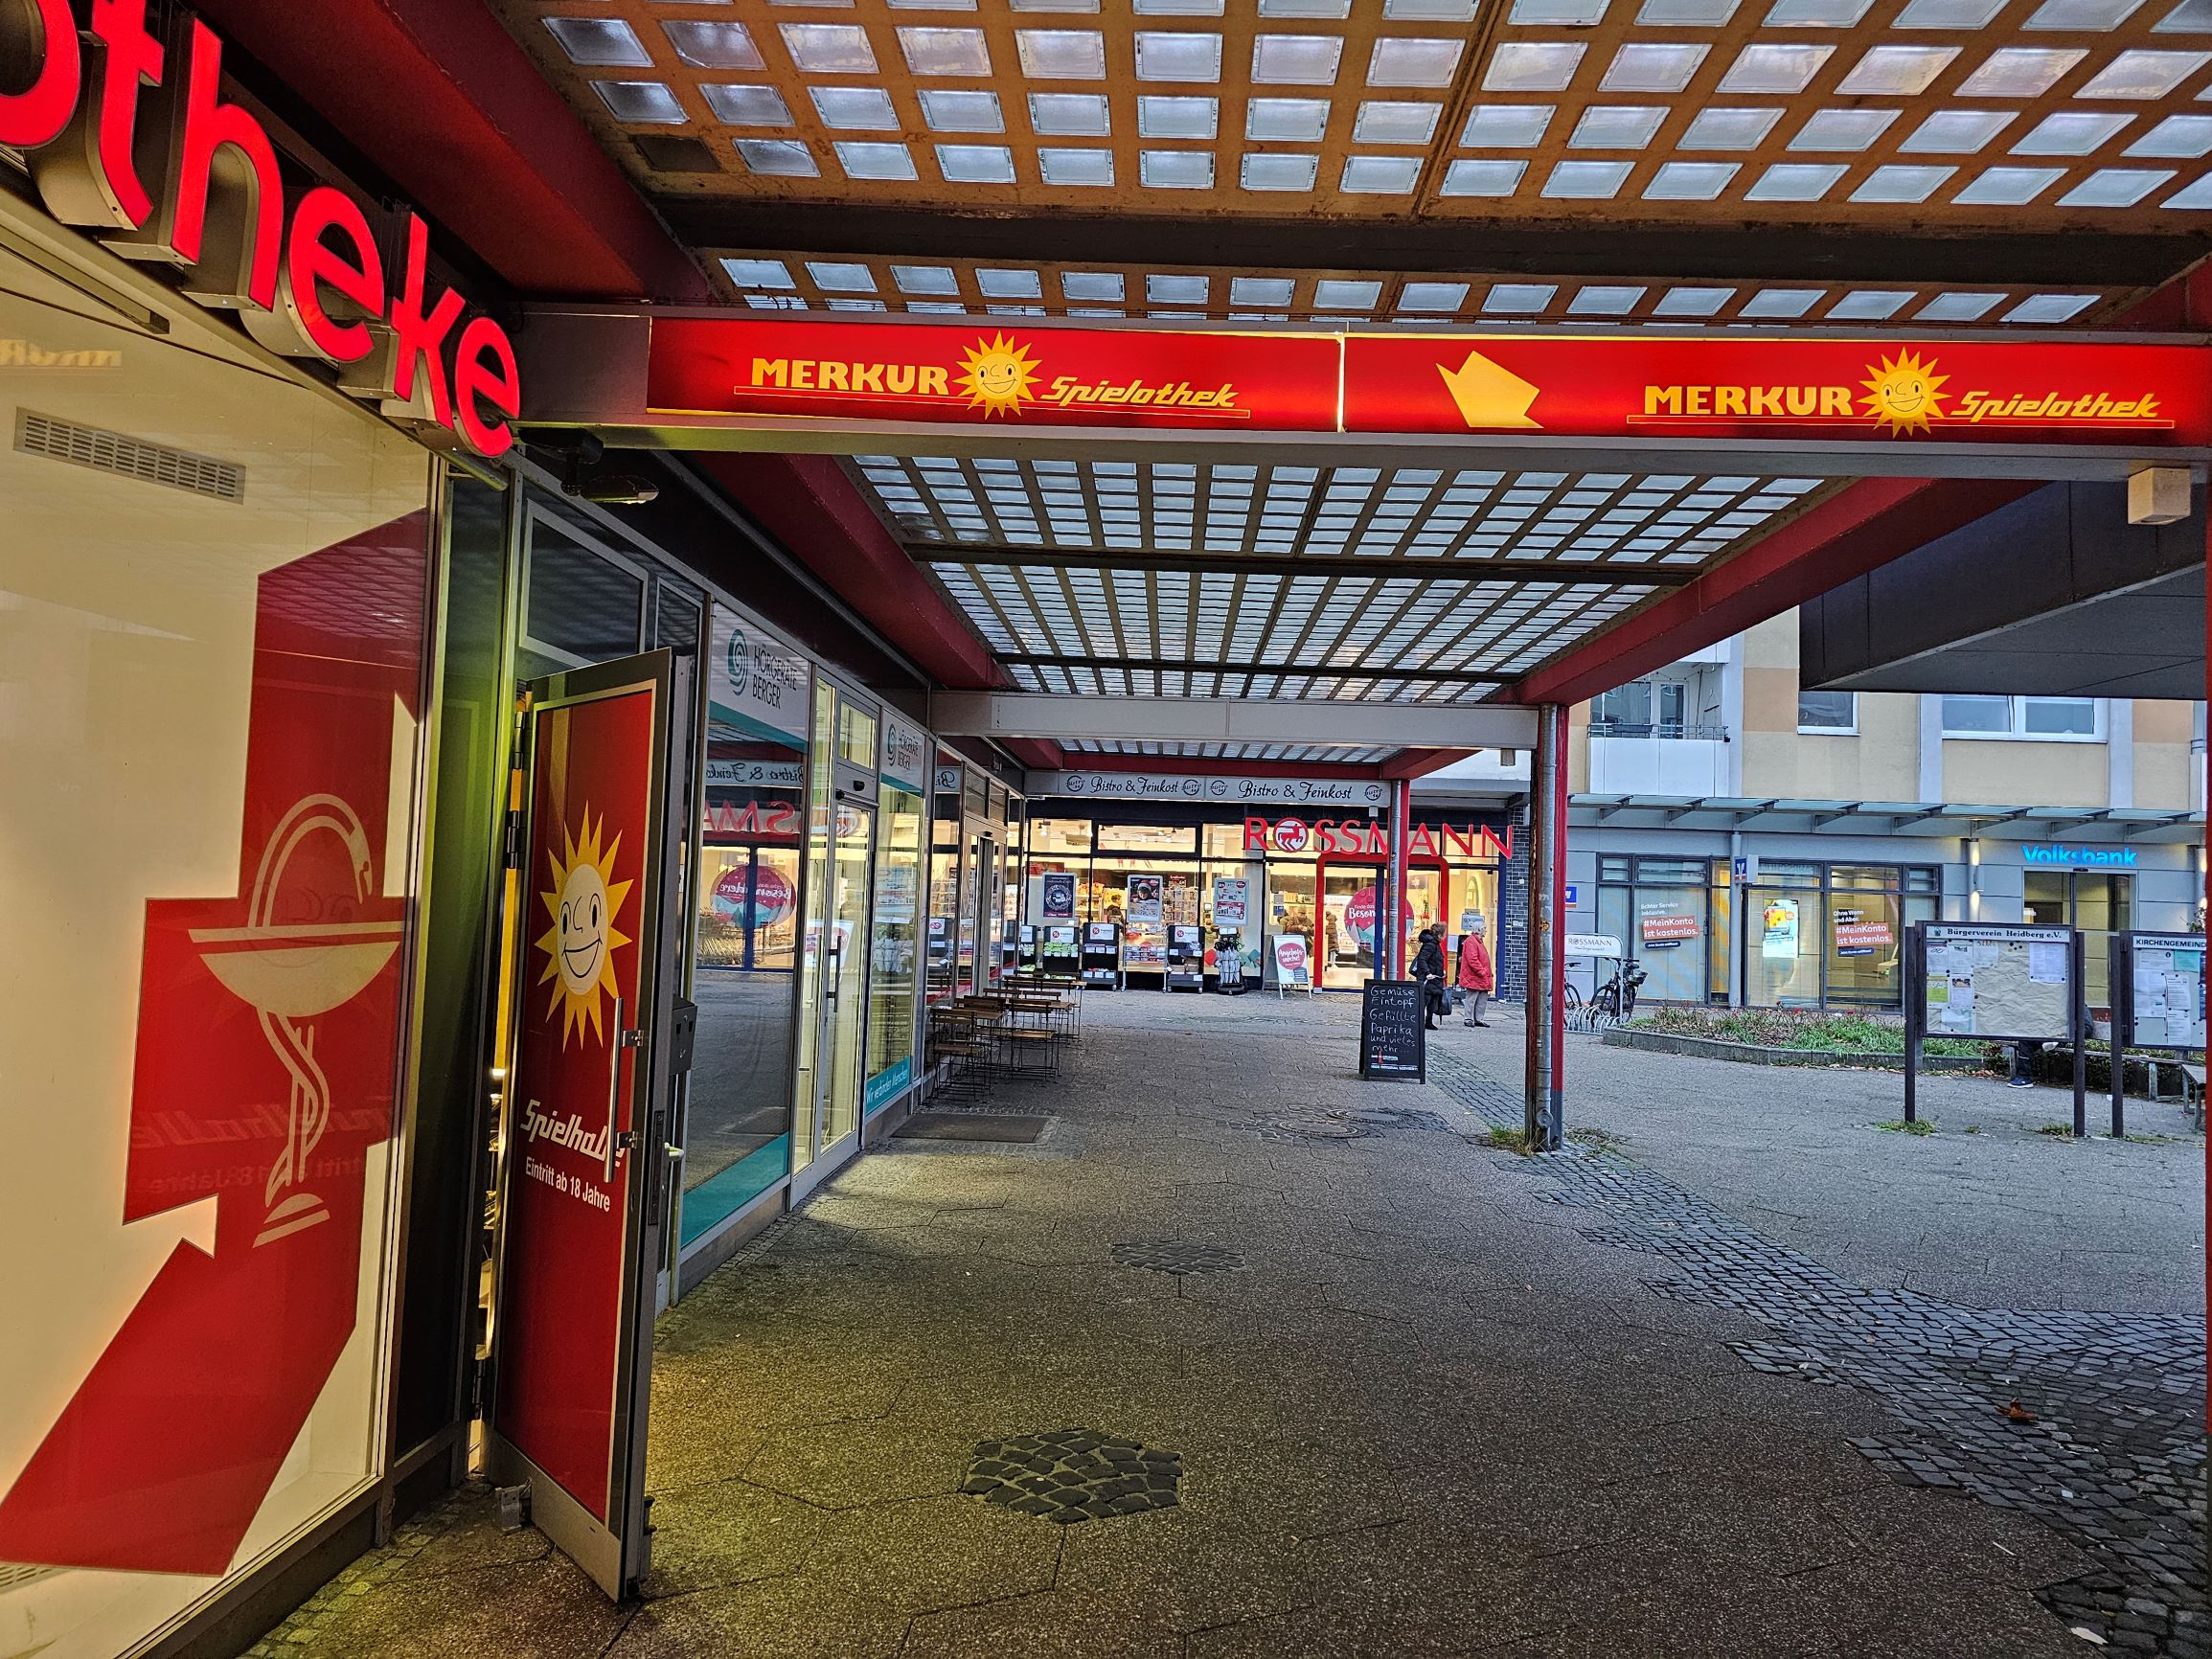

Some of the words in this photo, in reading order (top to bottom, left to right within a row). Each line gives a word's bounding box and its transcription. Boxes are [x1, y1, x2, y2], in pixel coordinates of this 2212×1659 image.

[751, 357, 949, 396] MERKUR
[1041, 375, 1243, 409] Spielothek
[1644, 384, 1854, 416] MERKUR
[1949, 390, 2159, 422] Spielothek
[754, 644, 797, 692] HÖRGERÄTE
[752, 673, 781, 710] BERGER
[1090, 776, 1122, 793] Bistro
[1126, 780, 1135, 792] &
[1136, 777, 1177, 795] Feinkost
[1238, 780, 1279, 799] Bistro
[1284, 784, 1295, 798] &
[1299, 781, 1352, 801] Feinkost
[1245, 817, 1513, 859] ROSSMANN
[2022, 845, 2138, 867] Volksbank
[1644, 918, 1694, 927] #MeinKonto
[1836, 924, 1887, 934] #MeinKonto
[1644, 929, 1655, 938] ist
[1656, 927, 1699, 937] kostenlos.
[1837, 936, 1848, 944] ist
[1849, 935, 1892, 943] kostenlos.
[1948, 928, 2002, 937] Bürgerverein
[2006, 930, 2044, 939] Heidberg
[1568, 938, 1612, 946] ROSSMANN
[1371, 986, 1415, 996] Gemüse
[1371, 996, 1416, 1010] Eintopf
[1370, 1008, 1416, 1023] Gefüllte
[1371, 1022, 1415, 1037] Paprika
[1389, 1034, 1416, 1047] vieles
[525, 1155, 555, 1187] Eintritt
[556, 1170, 568, 1193] ab
[570, 1175, 581, 1198] 18
[582, 1181, 611, 1213] Jahre
